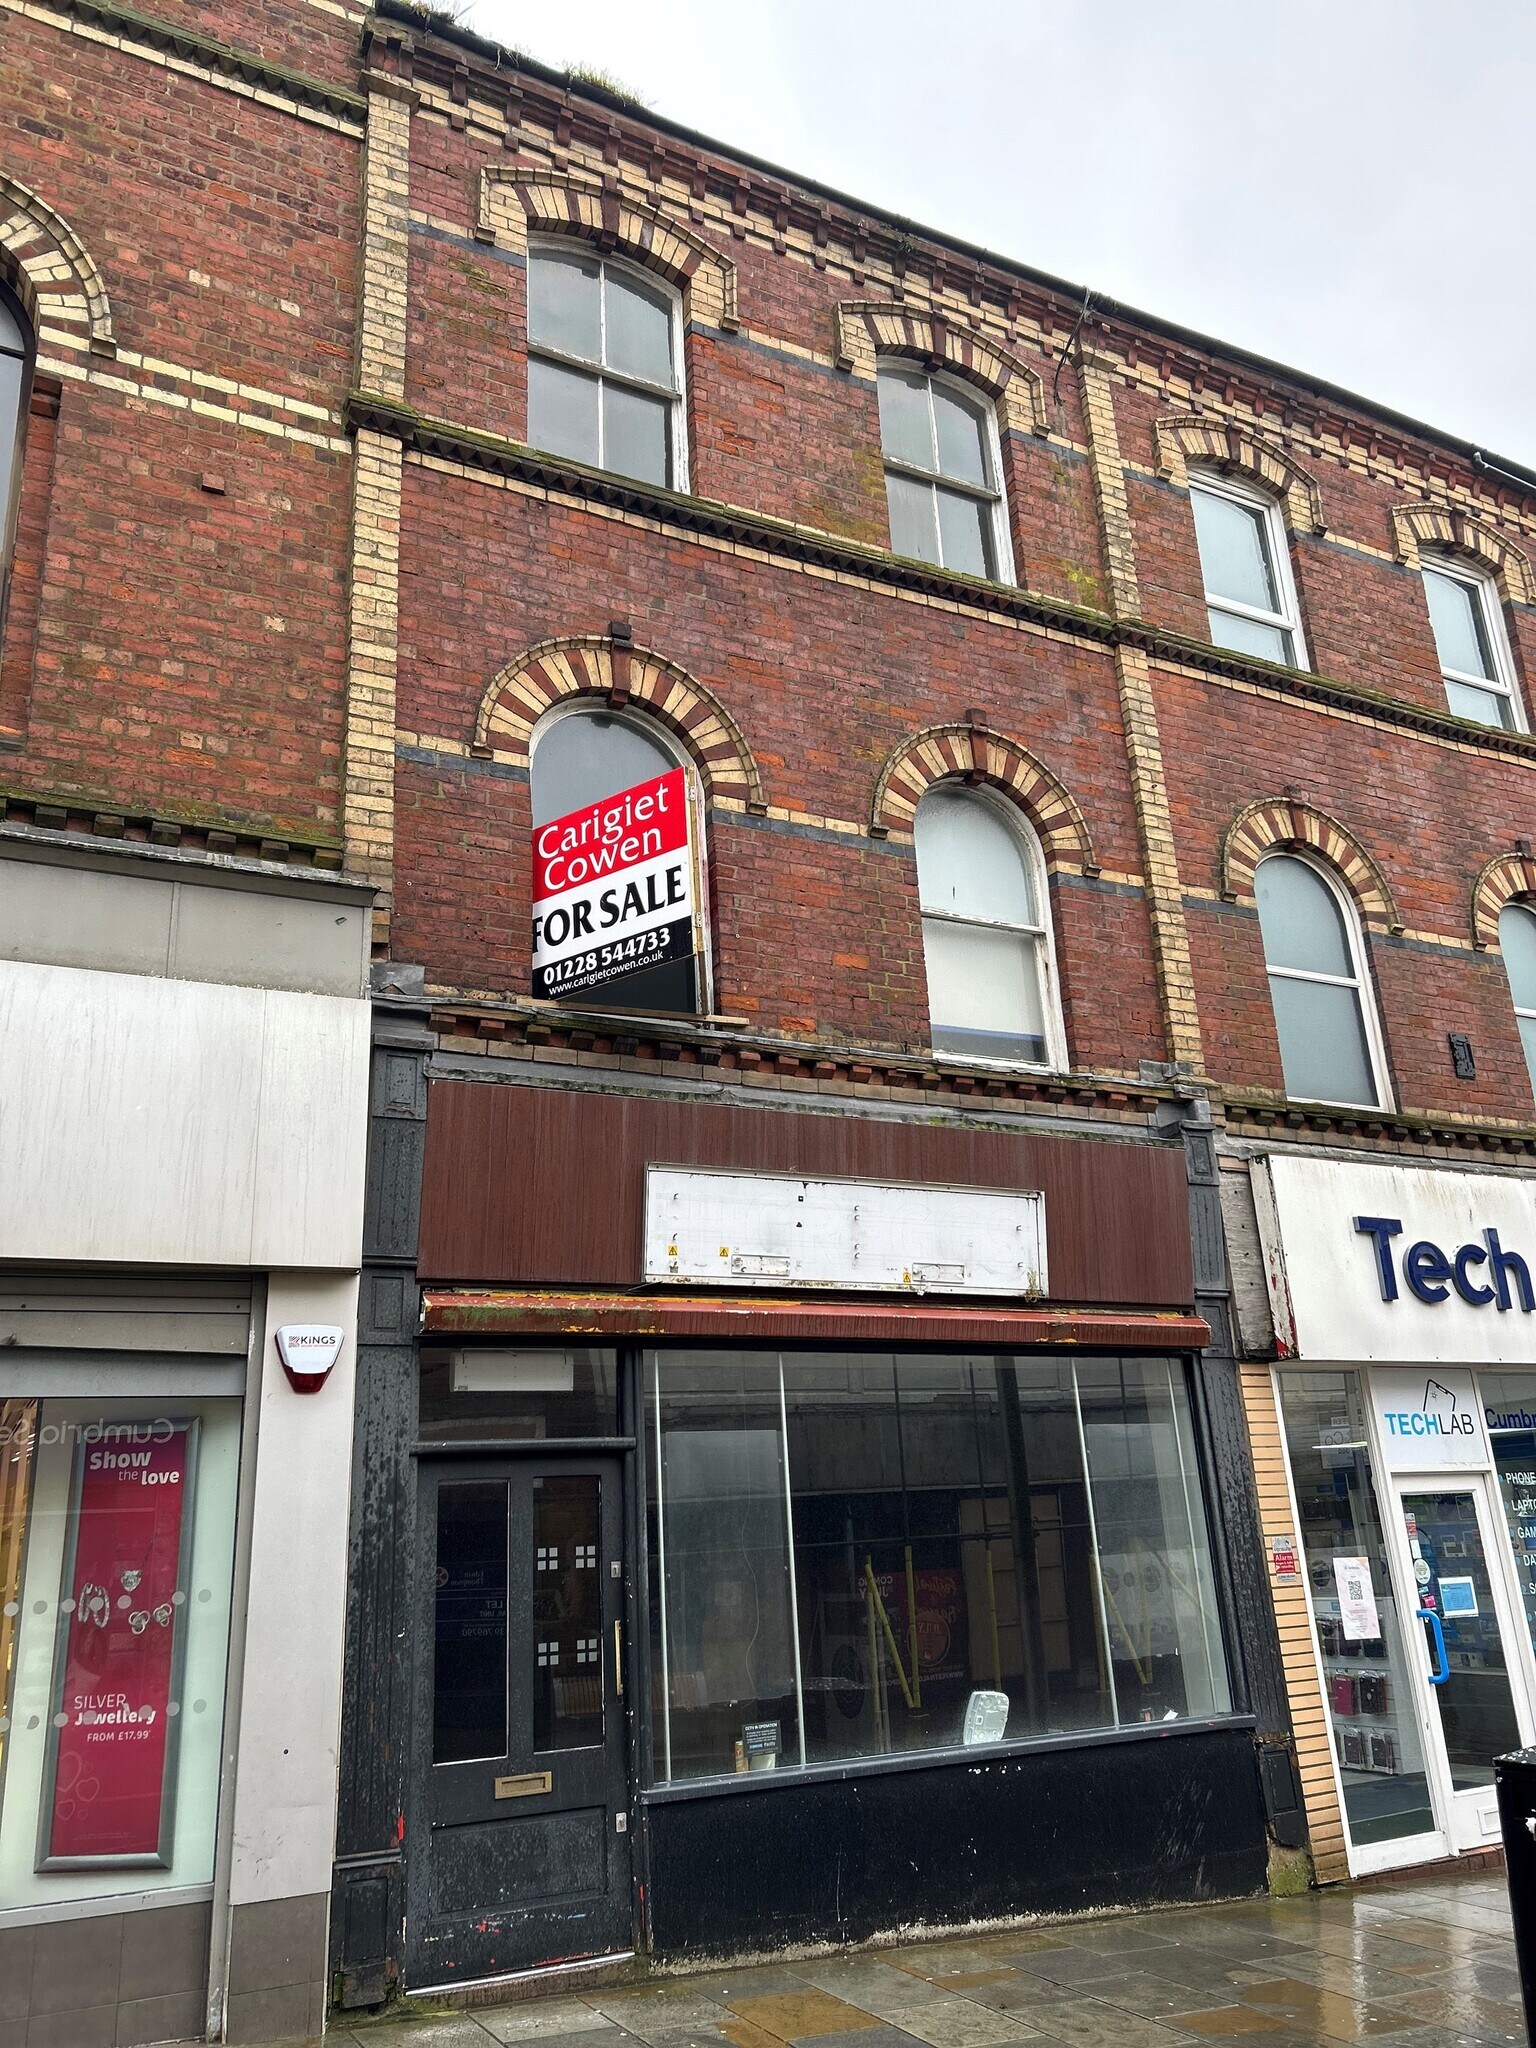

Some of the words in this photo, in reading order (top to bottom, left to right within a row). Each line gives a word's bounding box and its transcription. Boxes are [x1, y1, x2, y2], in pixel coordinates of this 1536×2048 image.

[538, 782, 669, 859] Carigiet
[543, 828, 663, 890] Cowen
[532, 899, 595, 955] FOR
[599, 864, 687, 929] SALE
[543, 951, 597, 985] 01228
[601, 927, 671, 966] 544733
[548, 950, 664, 996] www.carigietcowen.co.uk
[1352, 1216, 1536, 1312] Tech
[300, 1336, 336, 1344] KINGS
[1384, 1413, 1475, 1436] TECHLAB
[89, 1451, 152, 1470] Show
[118, 1470, 138, 1481] the
[141, 1470, 180, 1485] love
[1528, 1582, 1536, 1594] S
[74, 1693, 127, 1710] SILVER
[87, 1732, 115, 1742] FROM
